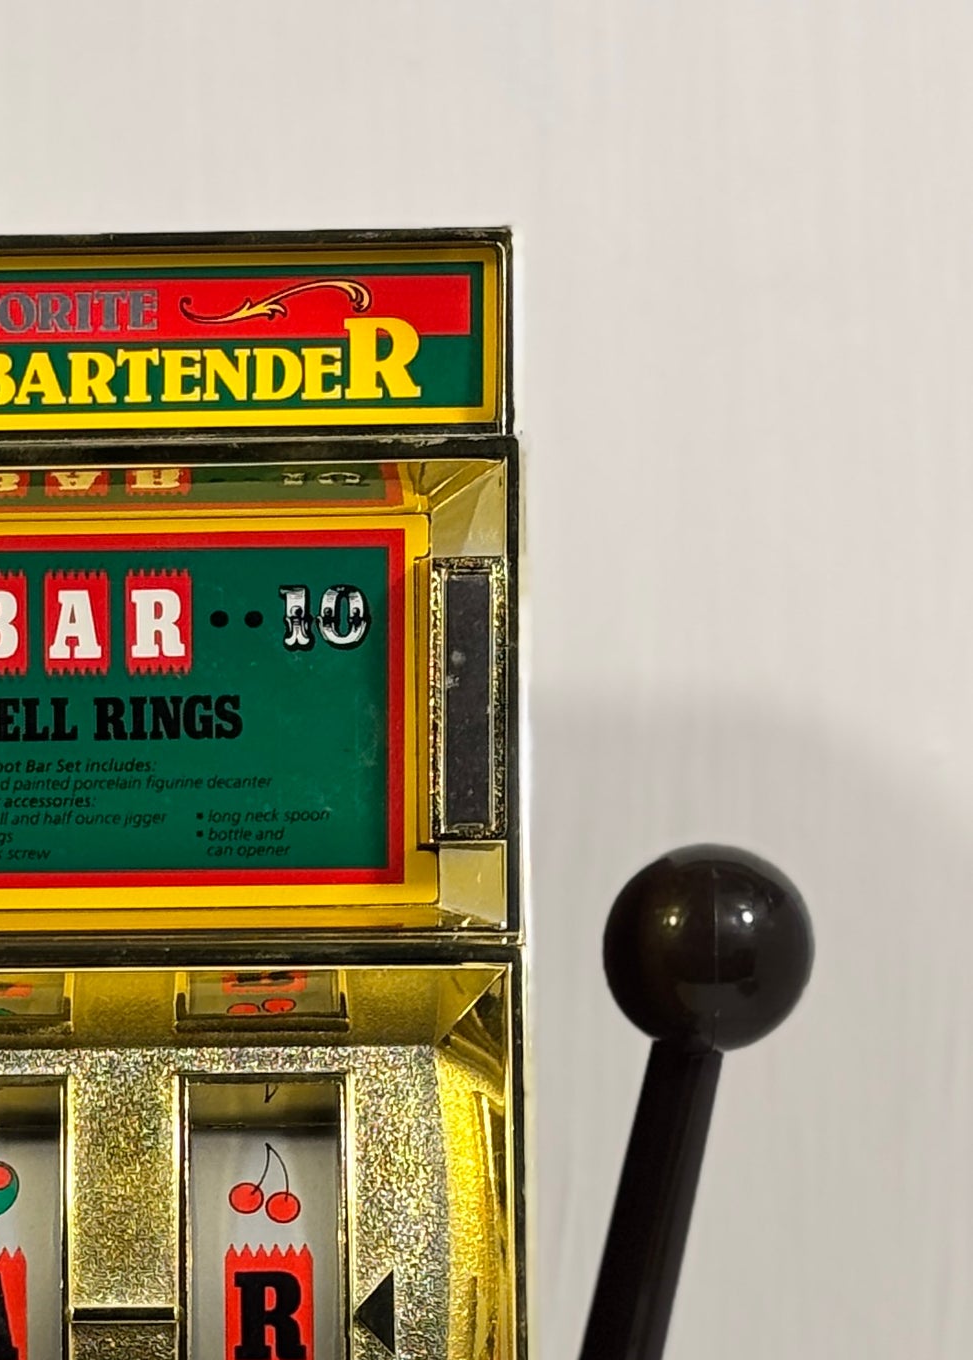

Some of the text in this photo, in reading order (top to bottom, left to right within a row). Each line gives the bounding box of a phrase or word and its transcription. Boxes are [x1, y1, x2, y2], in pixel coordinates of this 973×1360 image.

[279, 584, 372, 652] 10
[93, 694, 243, 741] RINGS
[25, 760, 52, 773] Bar
[56, 759, 82, 773] Set
[85, 758, 157, 773] includes:
[13, 776, 70, 794] painted
[73, 776, 141, 792] porcelain
[146, 776, 203, 793] figurine
[207, 775, 272, 789] decanter
[3, 795, 96, 808] accessories:
[11, 811, 40, 825] and
[43, 811, 74, 826] half
[75, 813, 121, 825] ounce
[123, 812, 167, 828] jigger
[208, 808, 330, 826] long neck spoon
[208, 827, 285, 841] bottle and
[7, 848, 51, 860] screw
[207, 845, 291, 858] can opener
